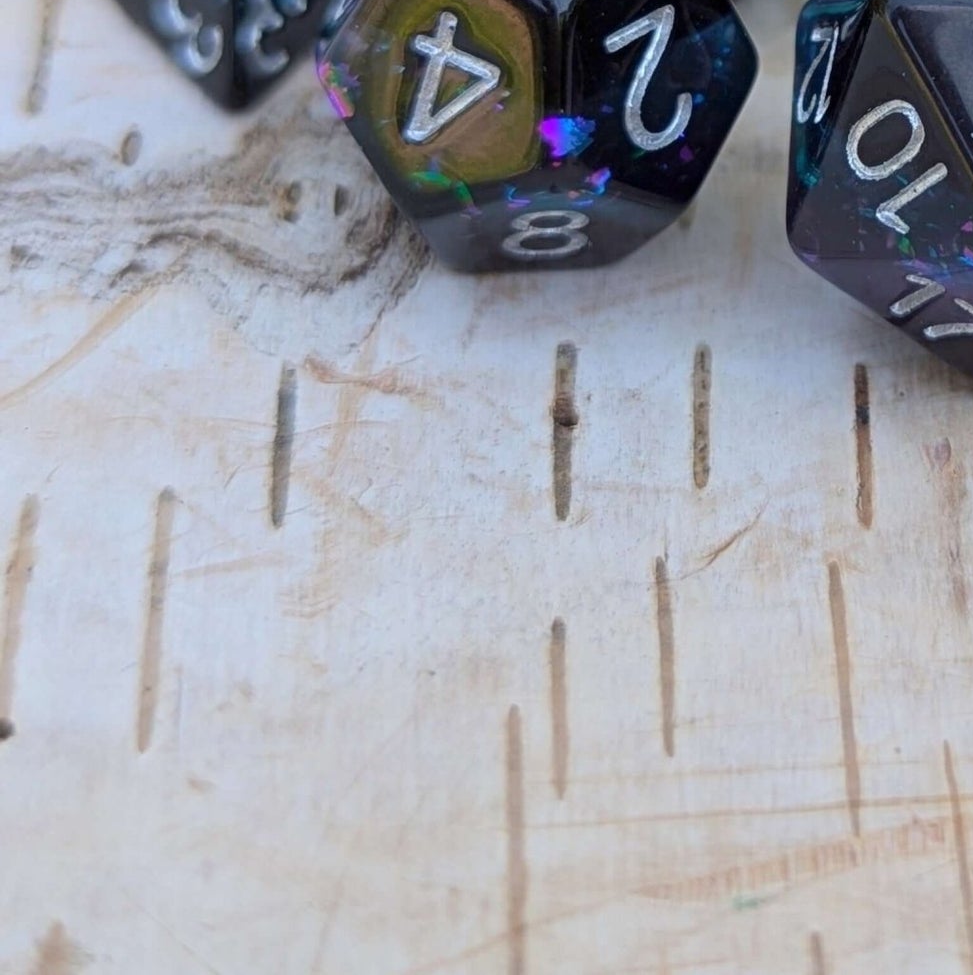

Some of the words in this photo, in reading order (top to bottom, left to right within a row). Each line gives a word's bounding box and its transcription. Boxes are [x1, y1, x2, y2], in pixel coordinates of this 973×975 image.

[401, 10, 501, 144] 4
[603, 2, 693, 151] 2
[845, 99, 949, 235] 10
[501, 210, 591, 260] 8
